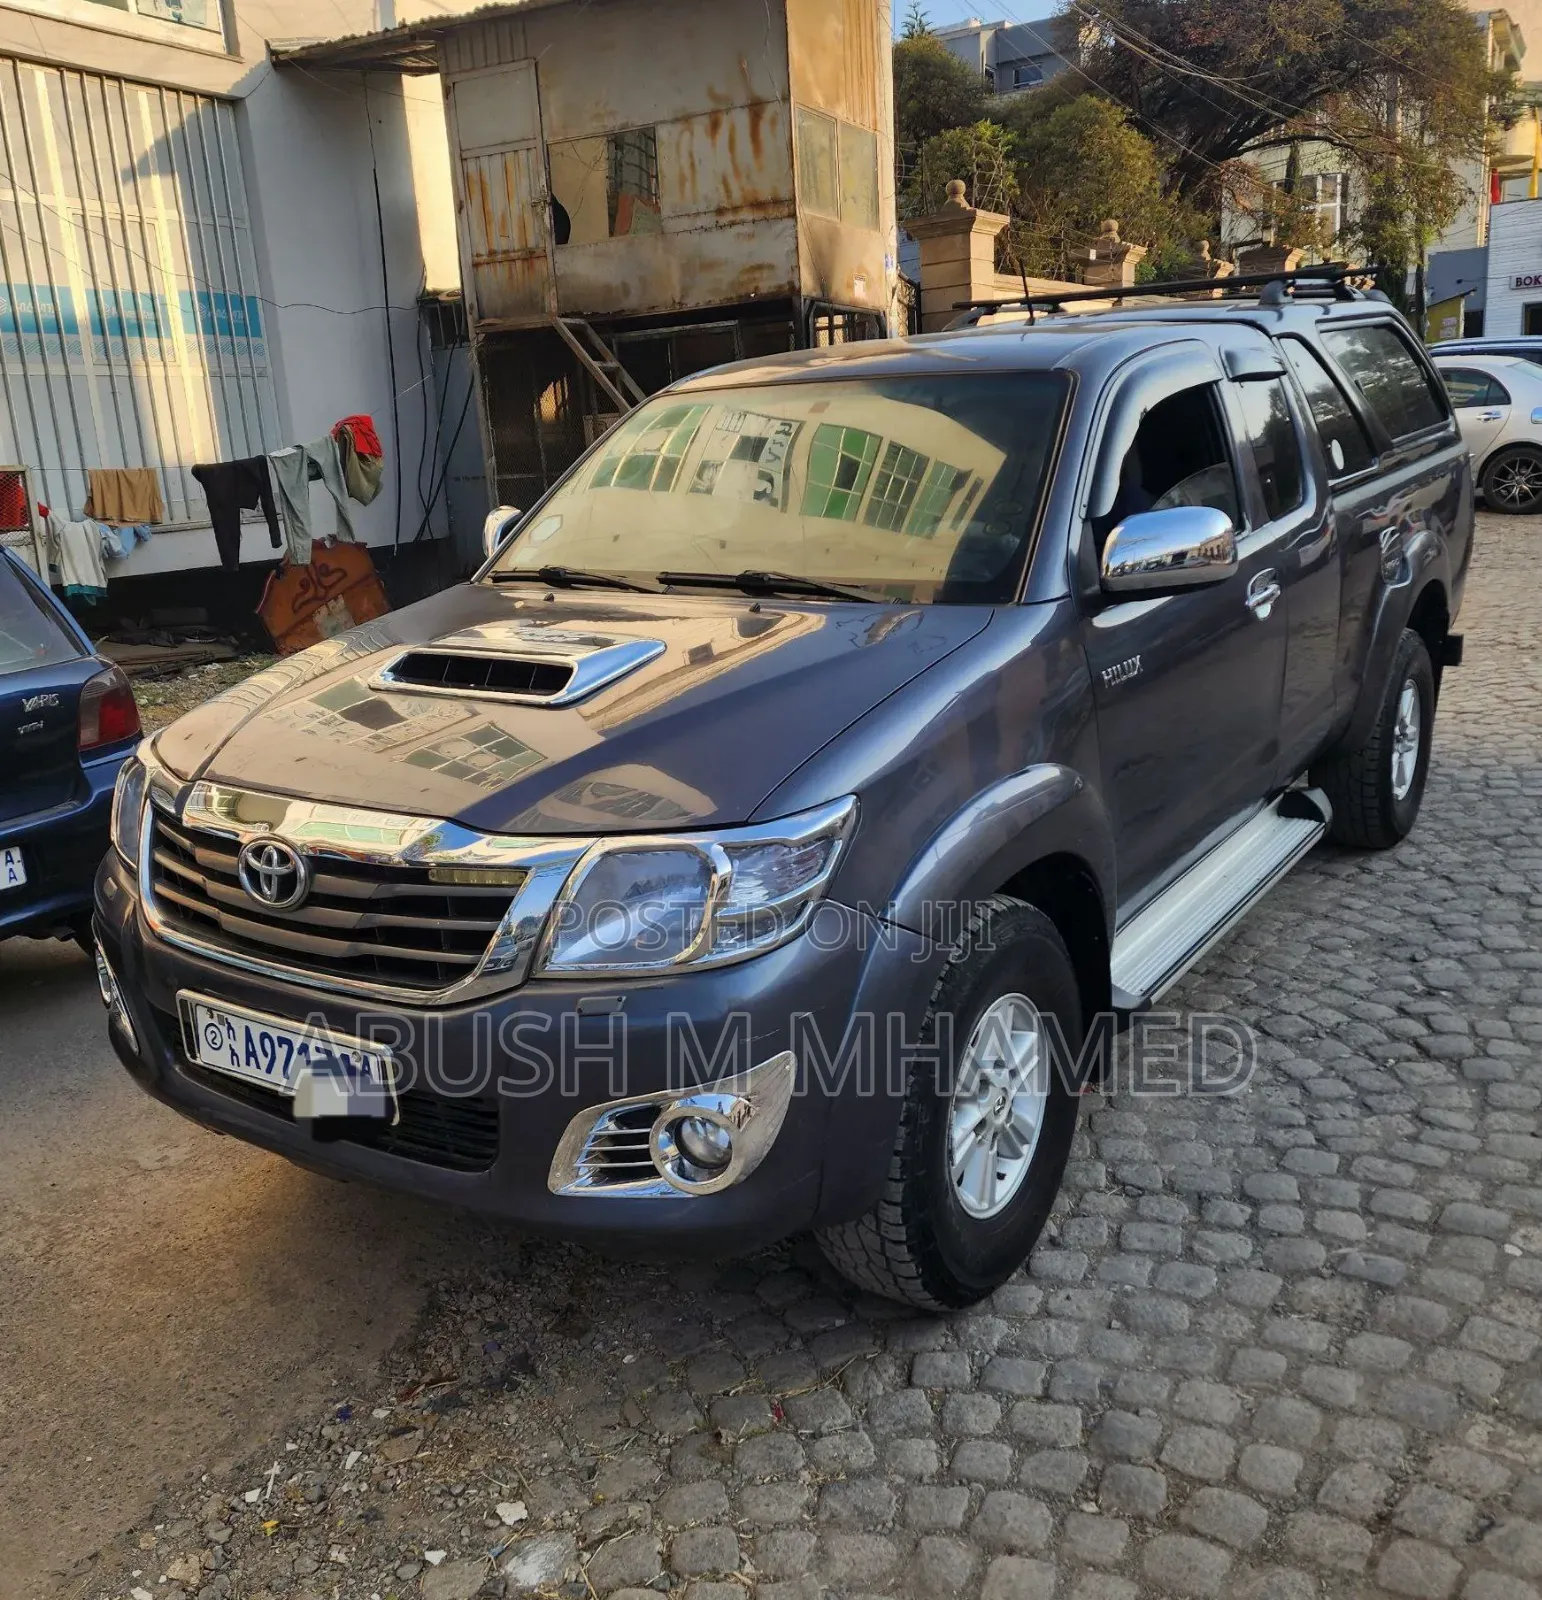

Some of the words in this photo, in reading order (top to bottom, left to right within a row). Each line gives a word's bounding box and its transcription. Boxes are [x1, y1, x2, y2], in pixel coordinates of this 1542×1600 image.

[1101, 654, 1144, 689] HILUX
[21, 693, 60, 713] YARIS
[5, 850, 15, 867] A
[8, 867, 18, 884] A
